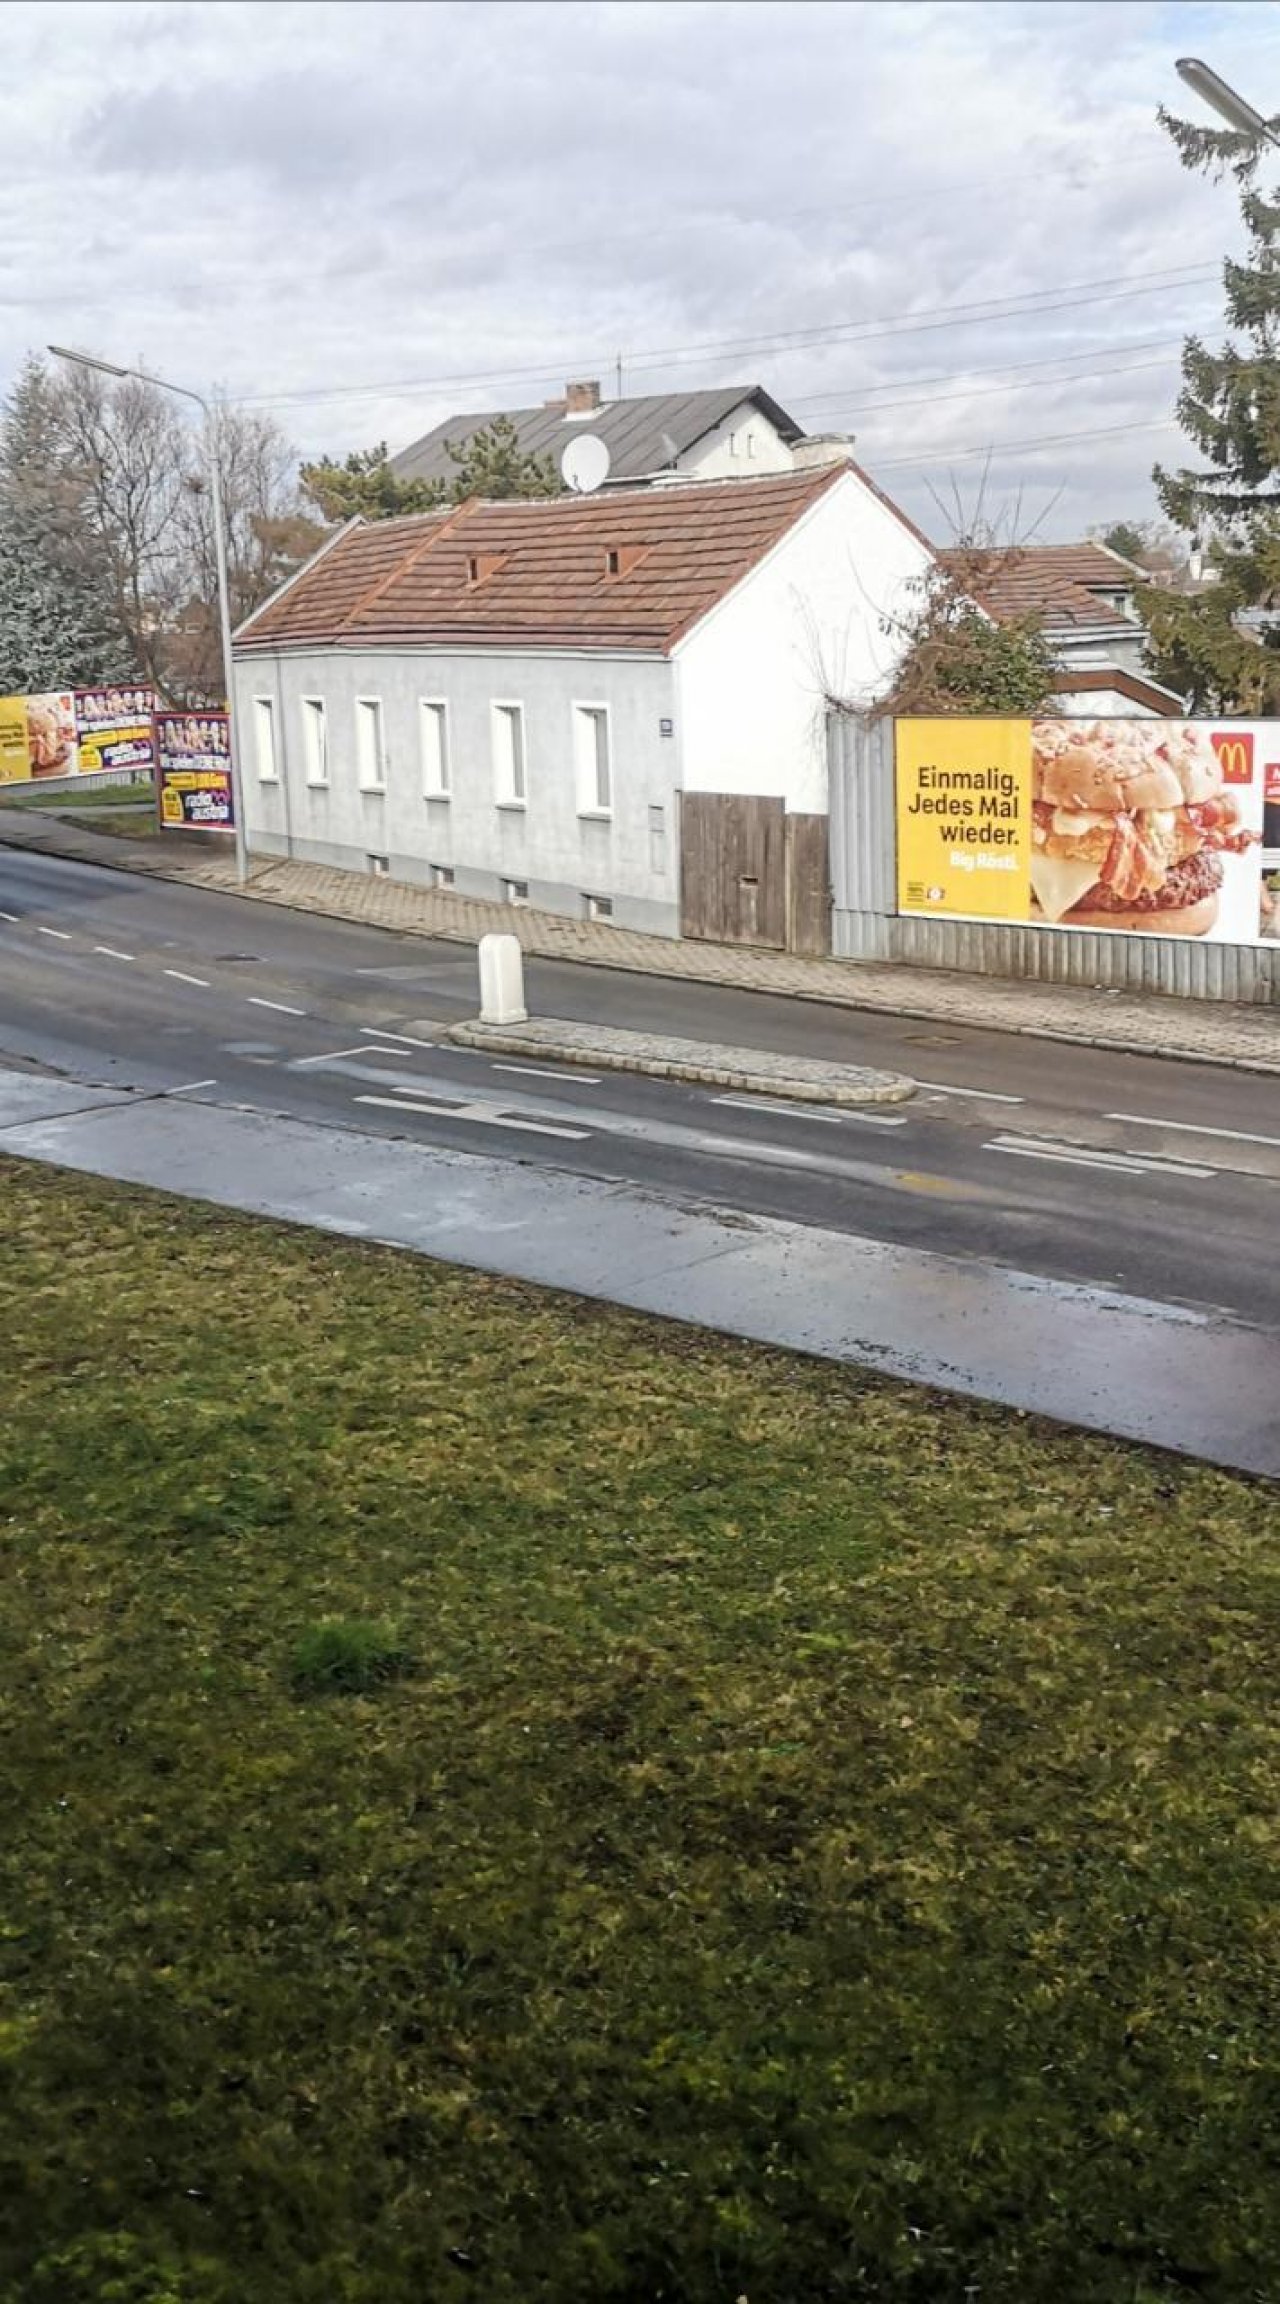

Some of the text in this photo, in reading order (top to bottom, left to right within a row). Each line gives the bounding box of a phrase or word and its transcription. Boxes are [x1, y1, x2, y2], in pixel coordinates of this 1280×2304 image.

[918, 765, 1020, 796] Einmalig.
[908, 793, 1019, 819] Jedes Mal
[940, 819, 1020, 845] wieder.
[950, 851, 975, 872] Big
